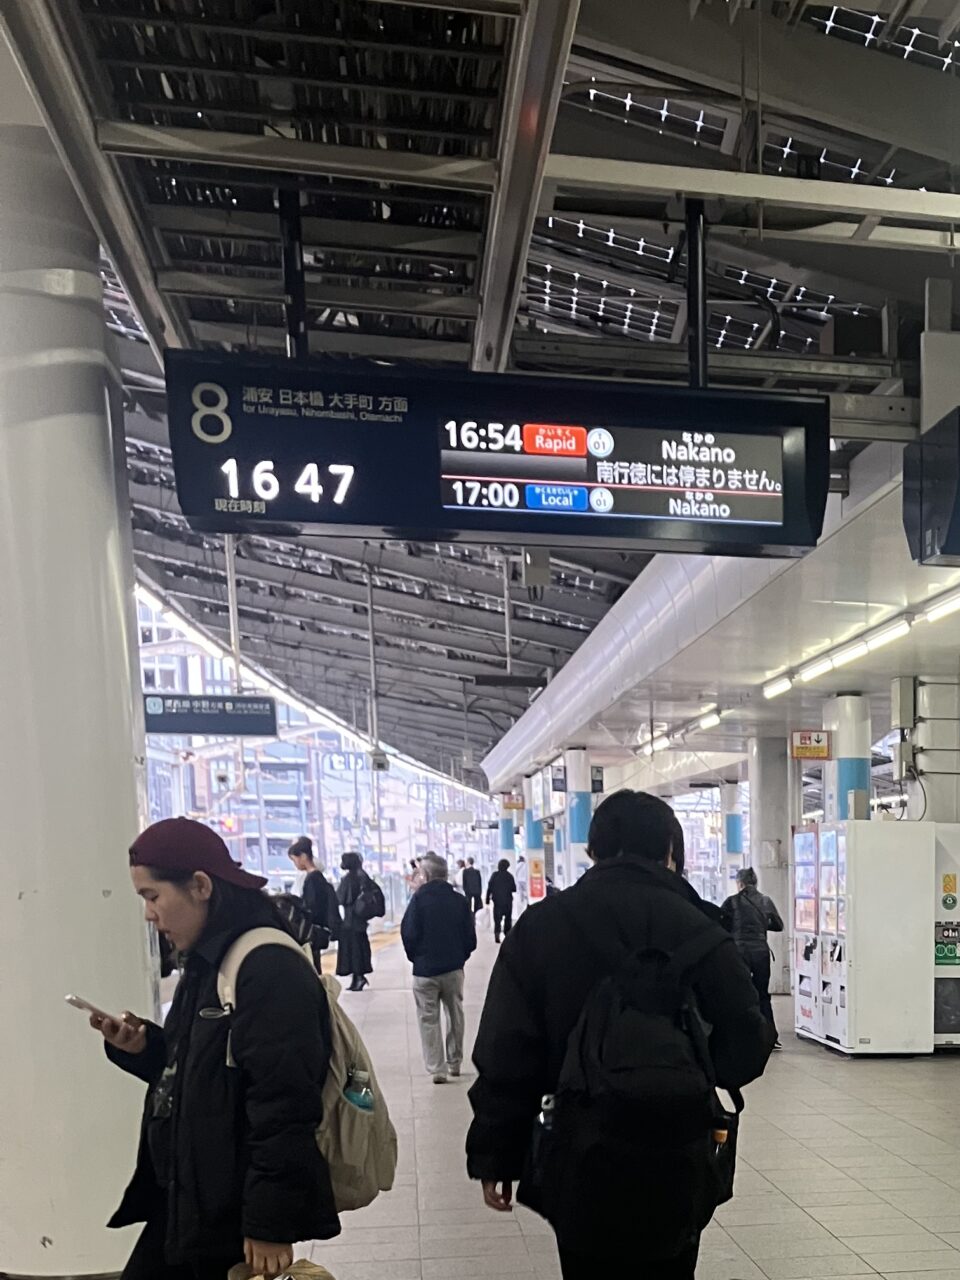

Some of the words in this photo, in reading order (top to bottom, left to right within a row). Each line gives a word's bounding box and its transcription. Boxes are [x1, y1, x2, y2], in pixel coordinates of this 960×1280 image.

[243, 386, 273, 404] 浦安
[279, 389, 325, 407] 日本橋
[329, 393, 373, 411] 大手町
[378, 396, 409, 413] 方面
[243, 403, 255, 413] for
[191, 382, 233, 444] 8
[445, 420, 523, 452] 16:54
[535, 435, 576, 453] Rapid
[593, 441, 606, 450] 01
[682, 432, 715, 444] なかの
[661, 440, 736, 463] Nakano
[221, 458, 280, 500] 16
[294, 462, 355, 504] 47
[596, 461, 782, 491] 南行徳には停まりません。
[214, 498, 266, 514] 現在時刻
[452, 481, 519, 508] 17:00
[541, 492, 573, 506] Local
[668, 498, 731, 517] Nakano
